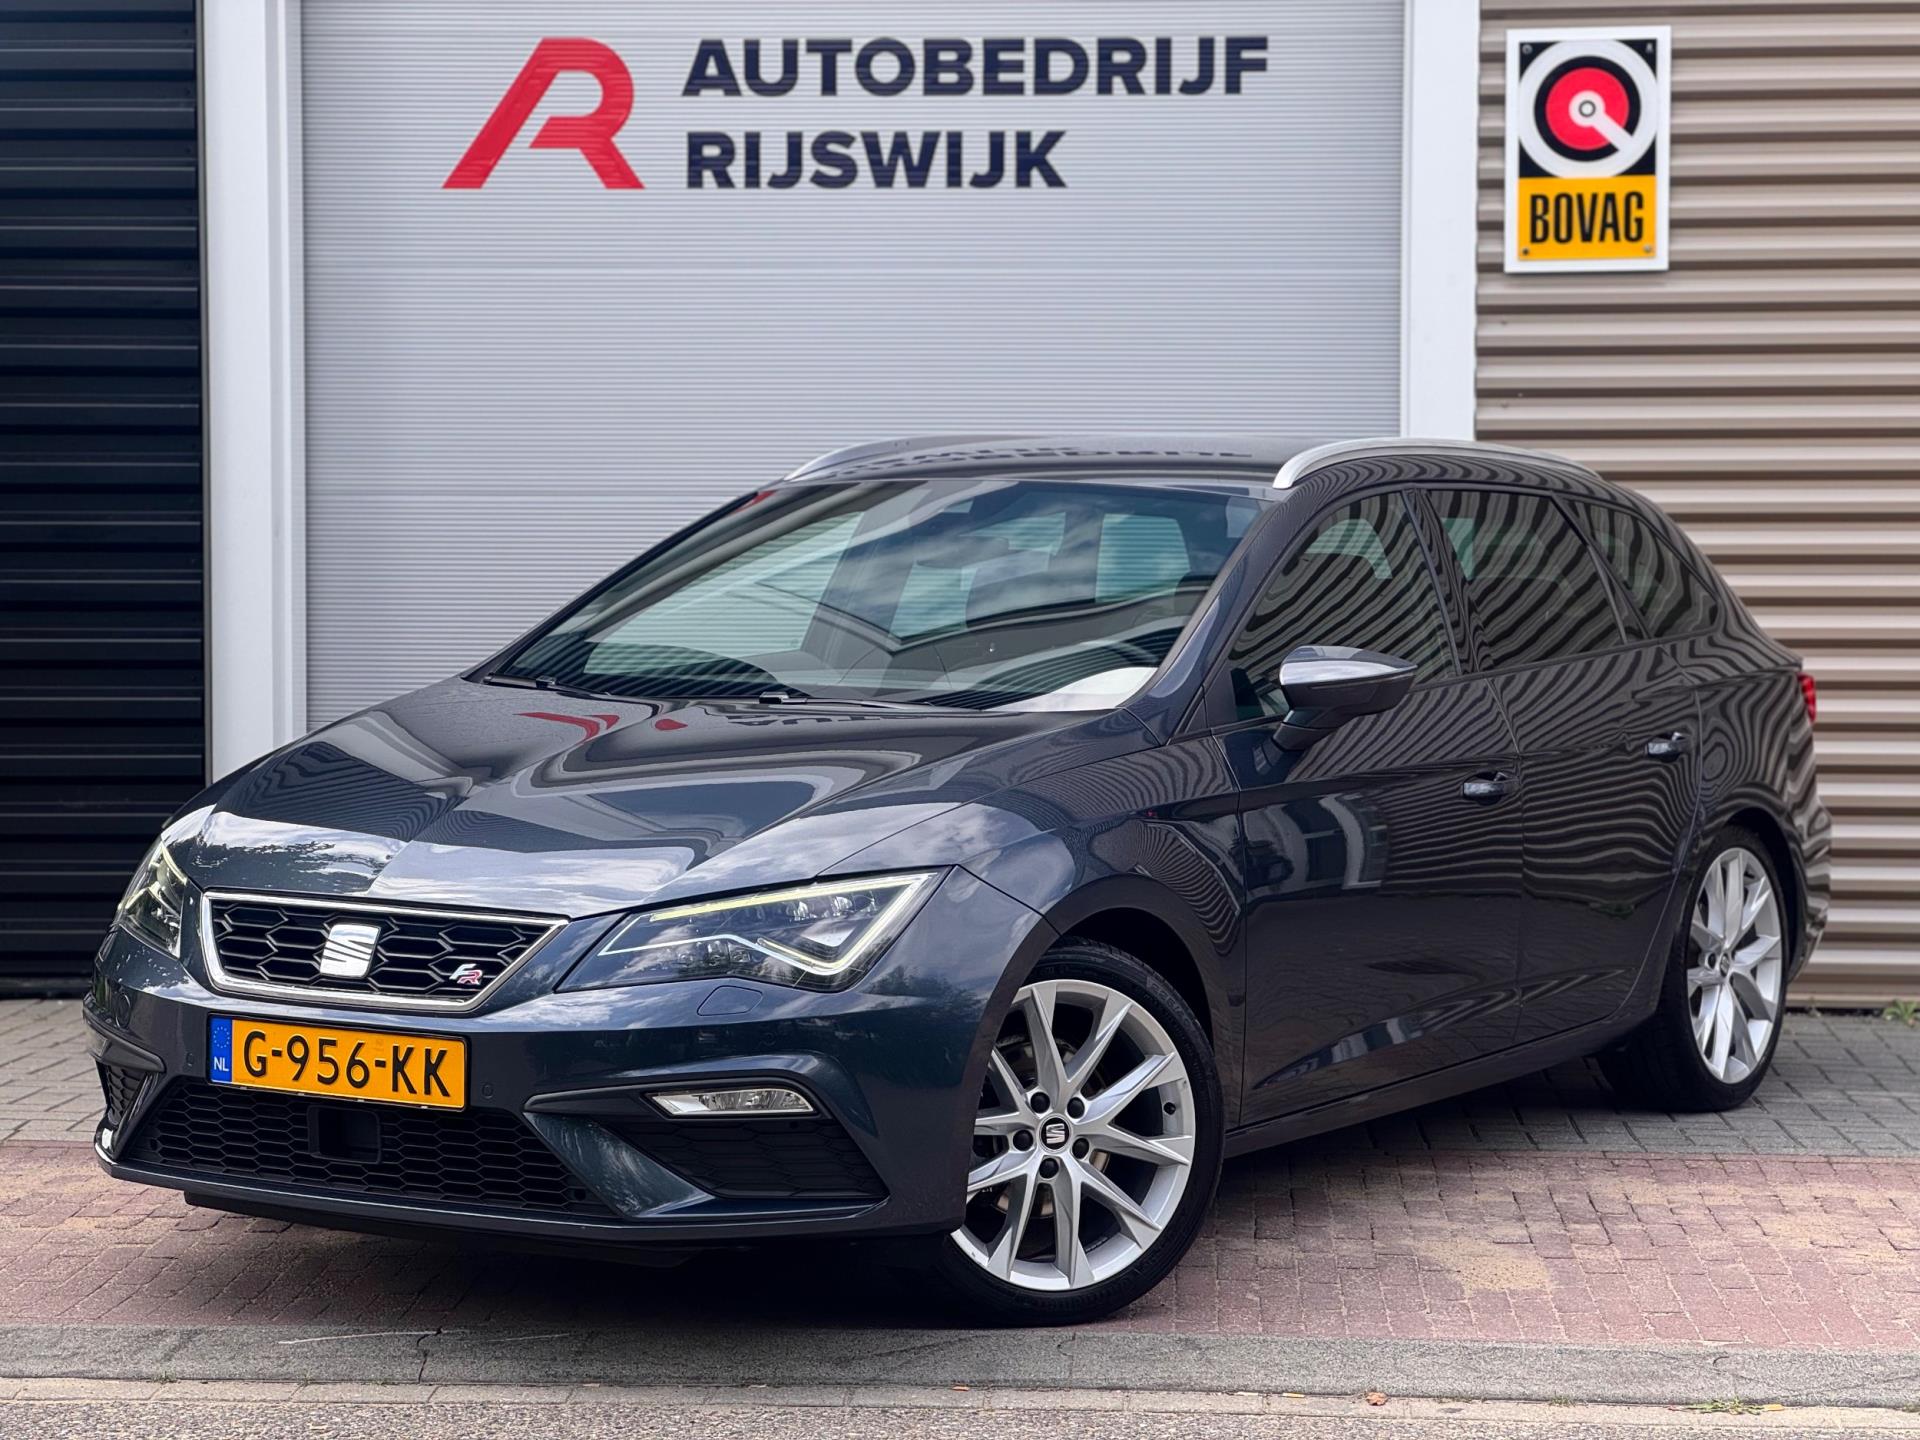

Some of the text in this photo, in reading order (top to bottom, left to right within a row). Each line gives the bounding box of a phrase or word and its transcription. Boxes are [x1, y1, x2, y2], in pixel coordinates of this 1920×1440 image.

[682, 37, 1268, 97] AUTOBEDRIJF
[687, 130, 1067, 190] RIJSWIJK
[1530, 191, 1644, 244] BOVAG
[213, 1056, 229, 1072] NL
[243, 1030, 451, 1098] G-956-KK
